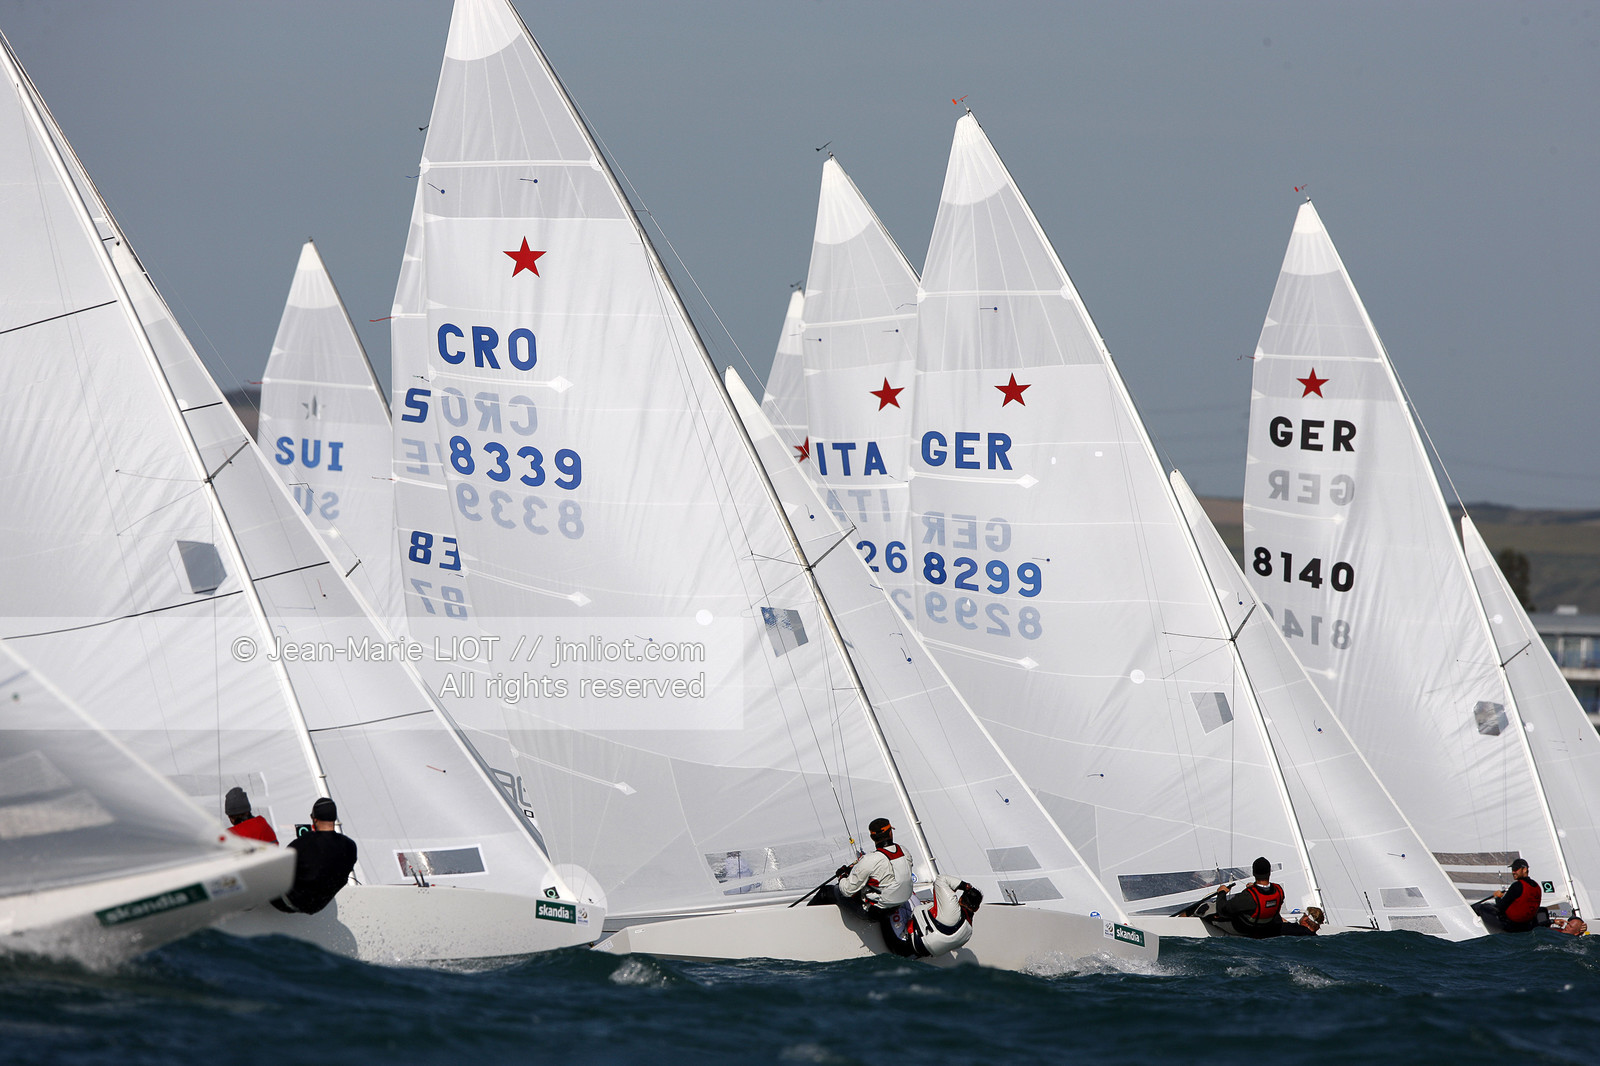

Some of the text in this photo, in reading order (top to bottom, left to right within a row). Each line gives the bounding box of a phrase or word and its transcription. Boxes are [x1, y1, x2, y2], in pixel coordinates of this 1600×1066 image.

[437, 323, 538, 371] CRO
[275, 436, 344, 471] SUI
[921, 430, 1013, 471] GER
[1269, 416, 1357, 452] GER
[449, 435, 582, 490] 8339
[816, 441, 887, 476] ITA
[923, 551, 1042, 598] 8299
[1252, 546, 1355, 592] 8140
[538, 903, 570, 919] skandia
